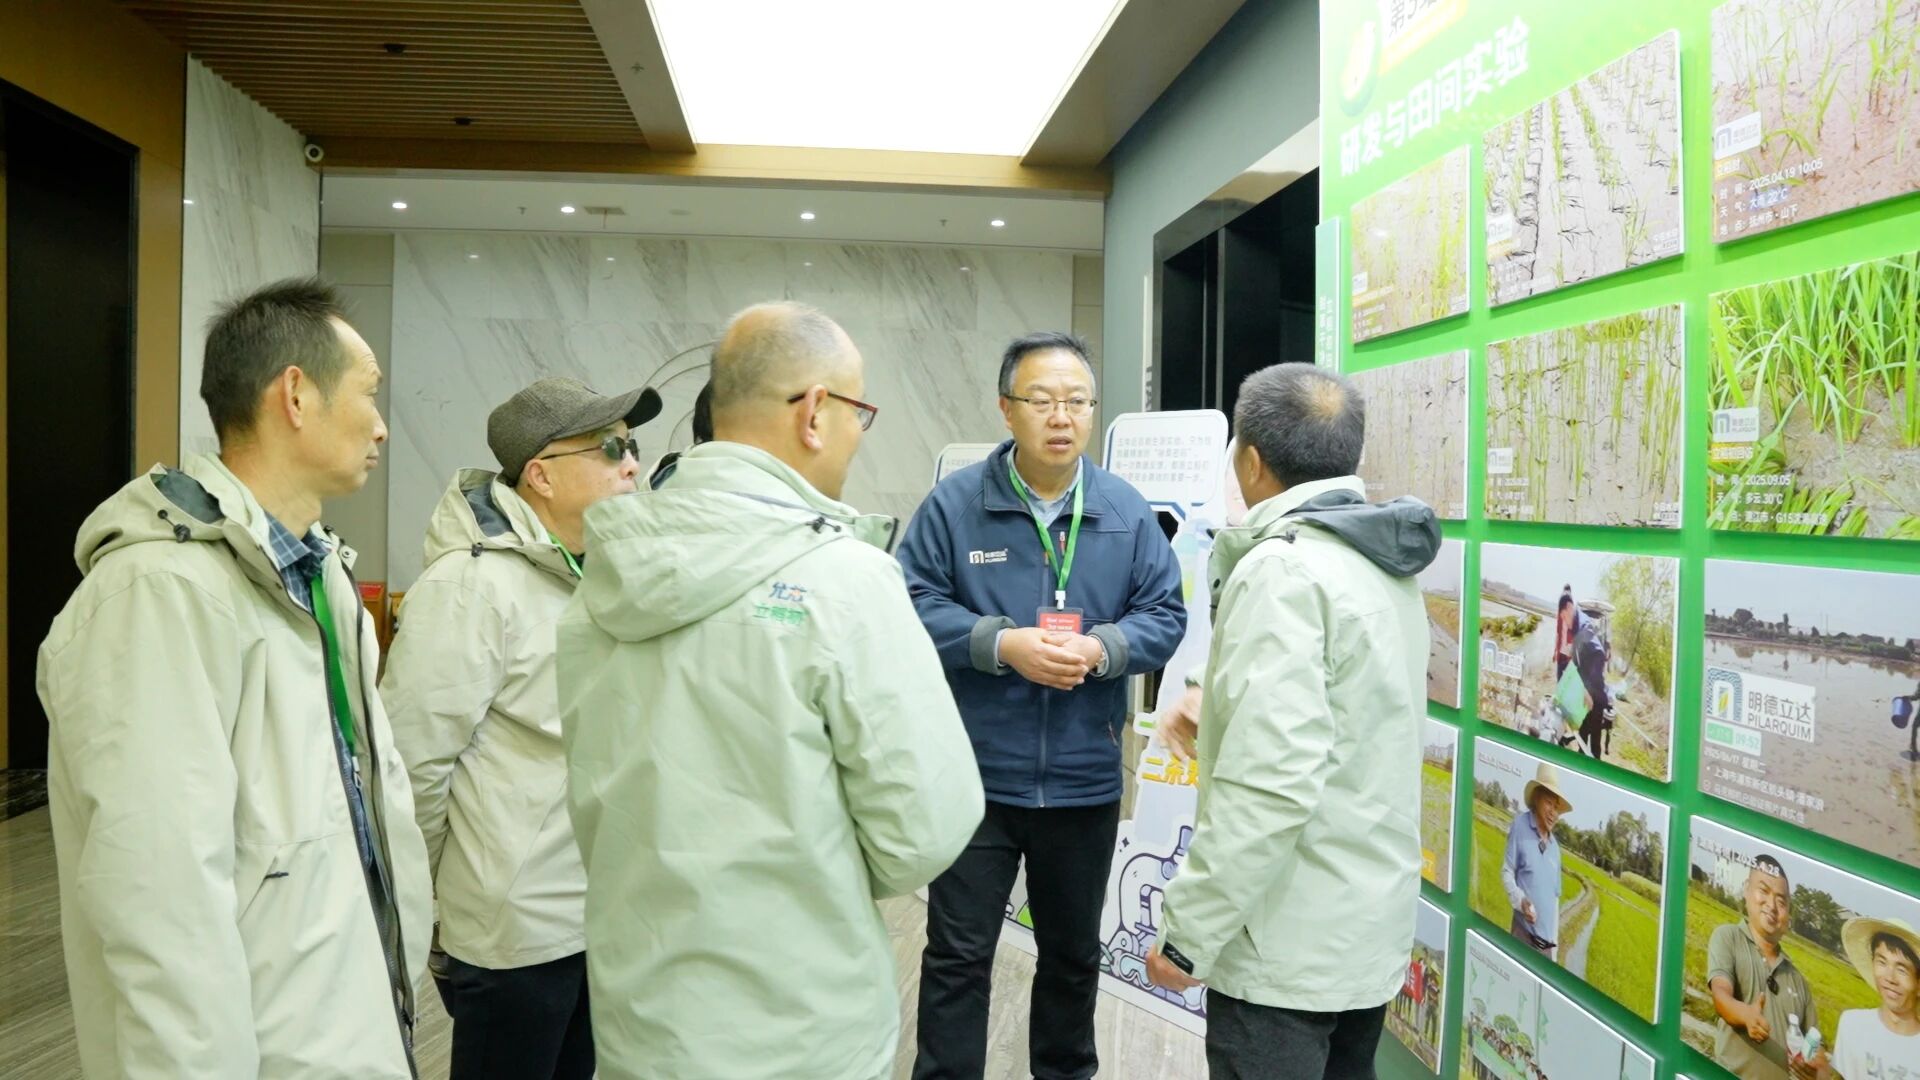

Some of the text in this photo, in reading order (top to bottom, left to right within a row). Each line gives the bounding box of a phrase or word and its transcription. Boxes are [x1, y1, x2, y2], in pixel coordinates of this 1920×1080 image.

[1340, 15, 1529, 177] 研发与田间实验
[1745, 474, 1791, 485] 2025.09.05
[1748, 690, 1812, 725] 明德立达
[1748, 712, 1812, 740] PILARQUIM
